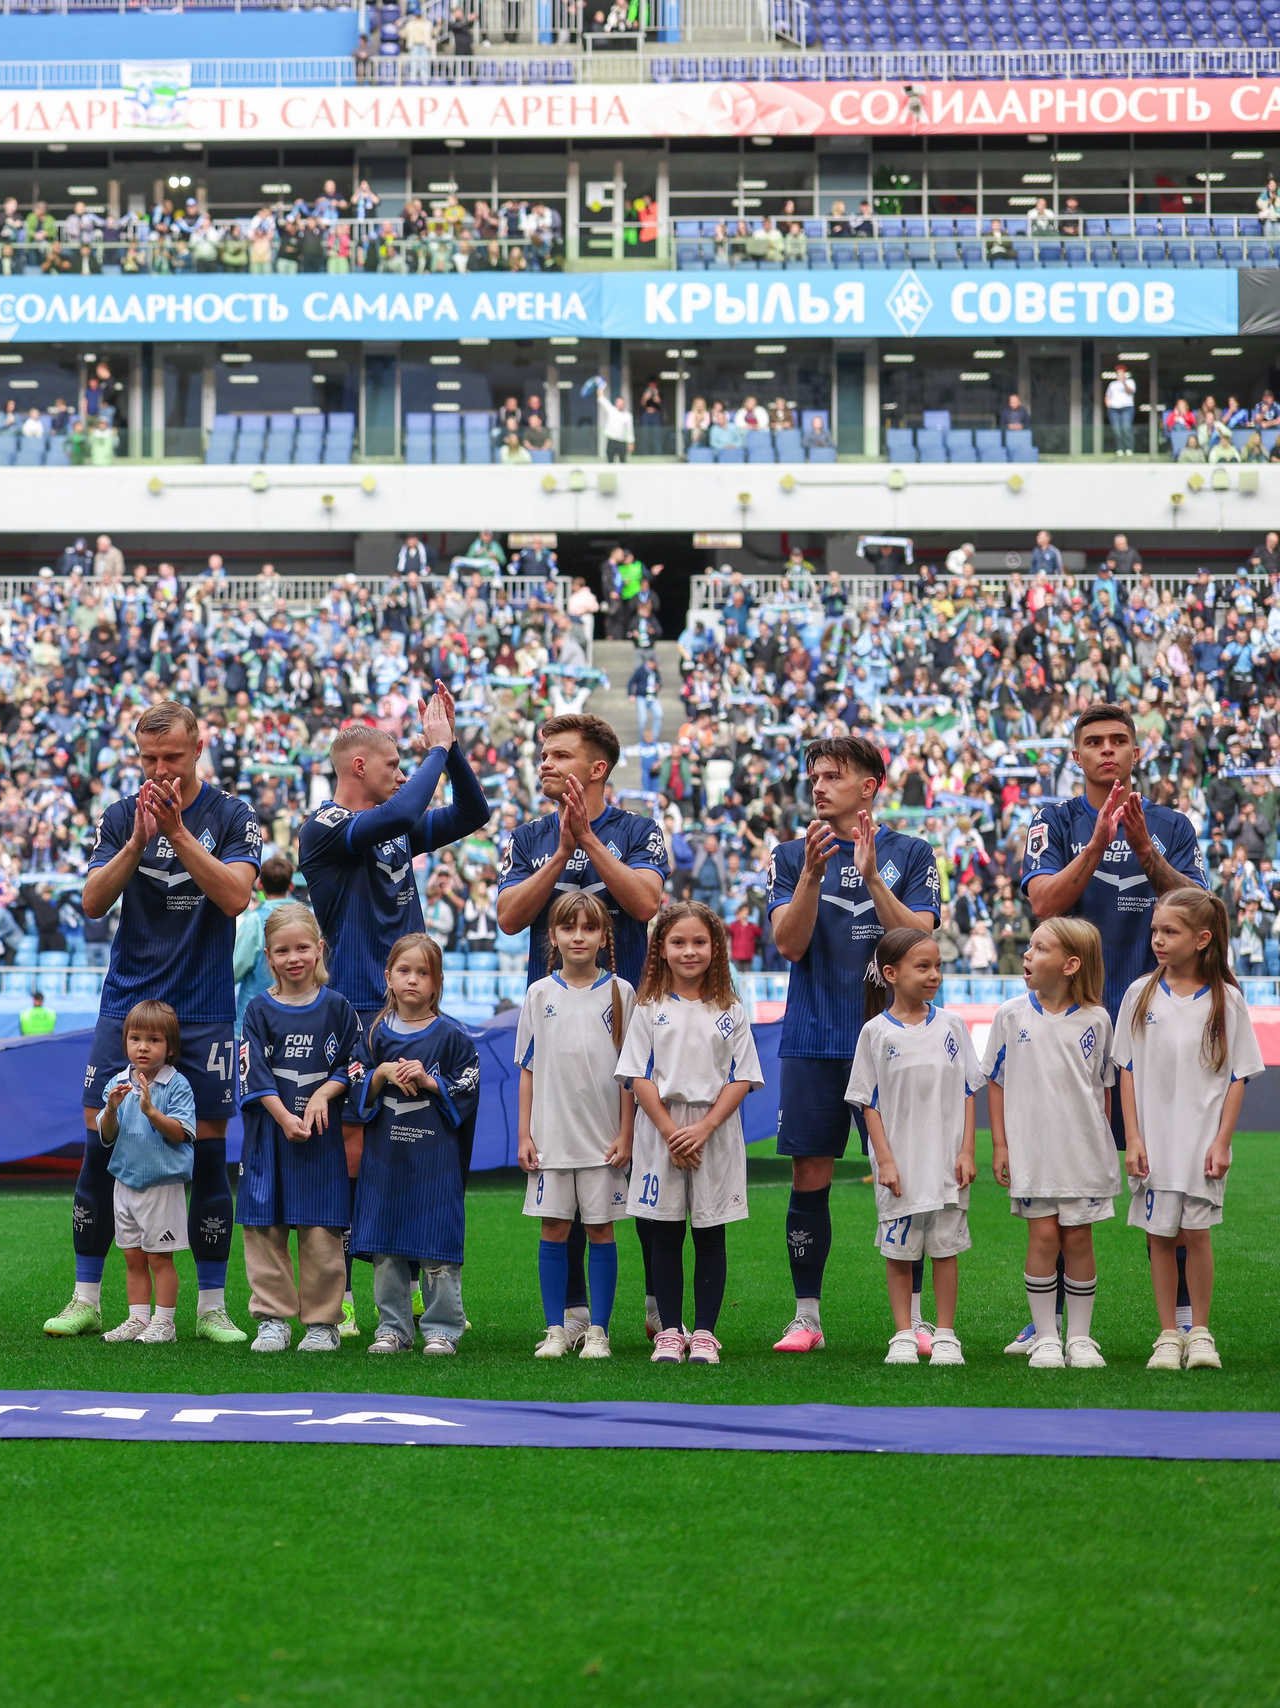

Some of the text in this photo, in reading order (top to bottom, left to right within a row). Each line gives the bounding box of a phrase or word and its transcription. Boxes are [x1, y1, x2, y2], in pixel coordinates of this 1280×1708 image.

[280, 96, 469, 129] САМАРА
[490, 95, 630, 127] АРЕНА
[303, 292, 459, 322] САМАРА
[472, 291, 588, 321] АРЕНА
[645, 281, 1176, 324] КРЫЛЬЯ СОВЕТОВ
[1102, 850, 1132, 862] BET
[565, 857, 589, 871] BET
[840, 876, 864, 888] BET
[284, 1034, 314, 1046] FON
[284, 1046, 314, 1058] BET
[206, 1040, 234, 1081] 47
[390, 1125, 436, 1136] ПРАВИТЕЛЬСТВО
[390, 1130, 423, 1139] САМАРСКОЙ
[389, 1135, 416, 1143] ОБЛАСТИ
[638, 1172, 659, 1207] 19
[1145, 1188, 1155, 1222] 9
[884, 1215, 913, 1247] 27
